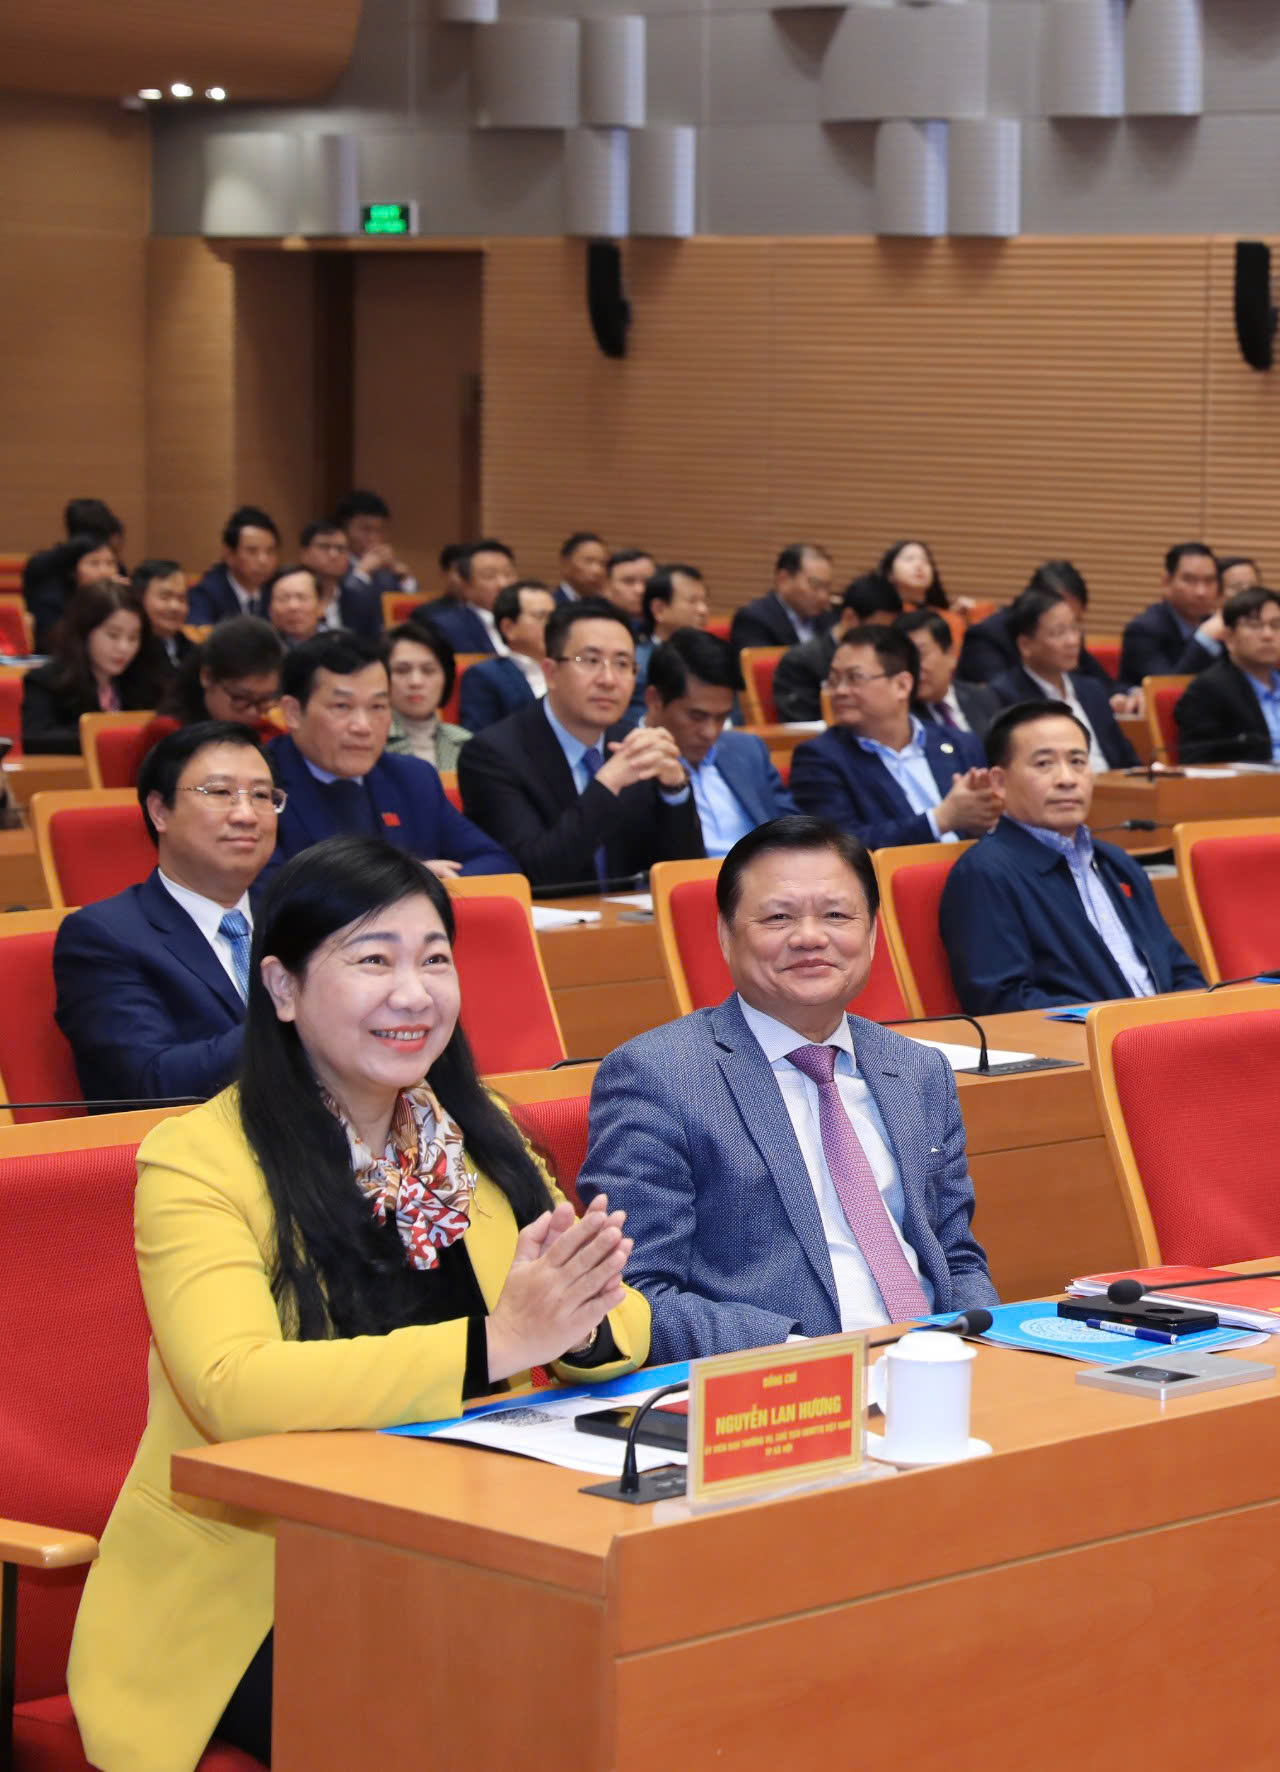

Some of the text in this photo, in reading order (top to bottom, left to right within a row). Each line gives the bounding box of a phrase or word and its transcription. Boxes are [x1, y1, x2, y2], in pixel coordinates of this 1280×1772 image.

[715, 1395, 842, 1436] NGUYỄN LAN HƯƠNG
